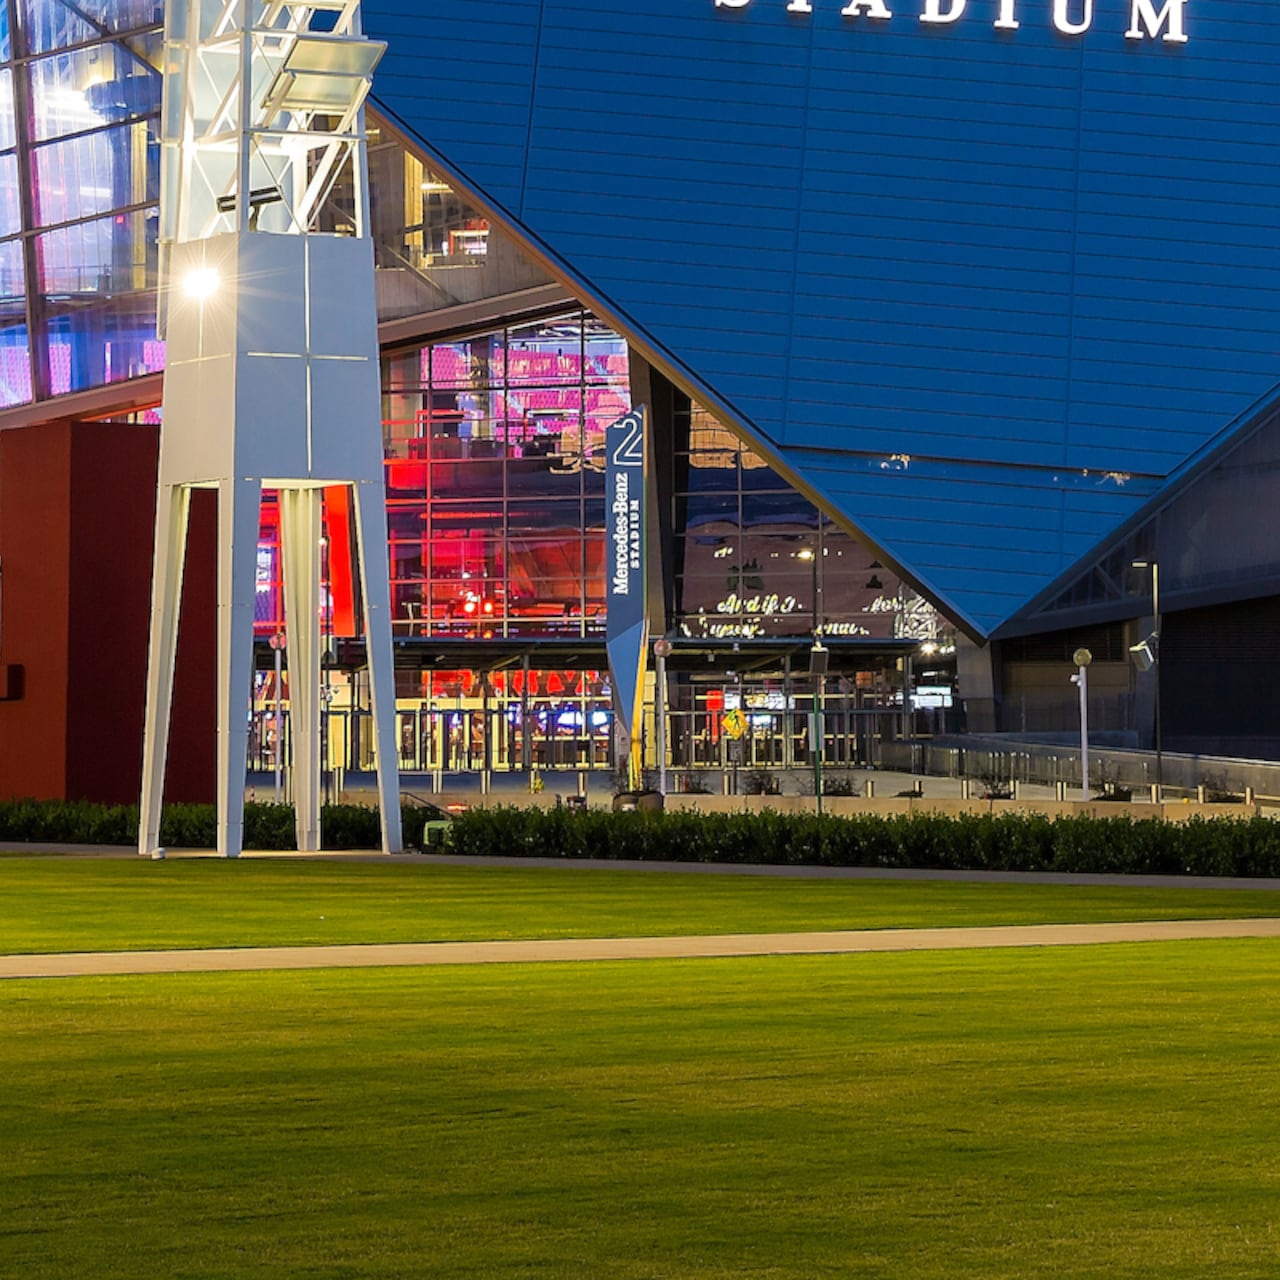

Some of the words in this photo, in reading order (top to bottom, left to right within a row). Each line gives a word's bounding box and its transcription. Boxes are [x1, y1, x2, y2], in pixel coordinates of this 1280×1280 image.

[613, 410, 643, 466] 2
[612, 472, 629, 596] Mercedes-Benz
[629, 499, 641, 569] STADIUM
